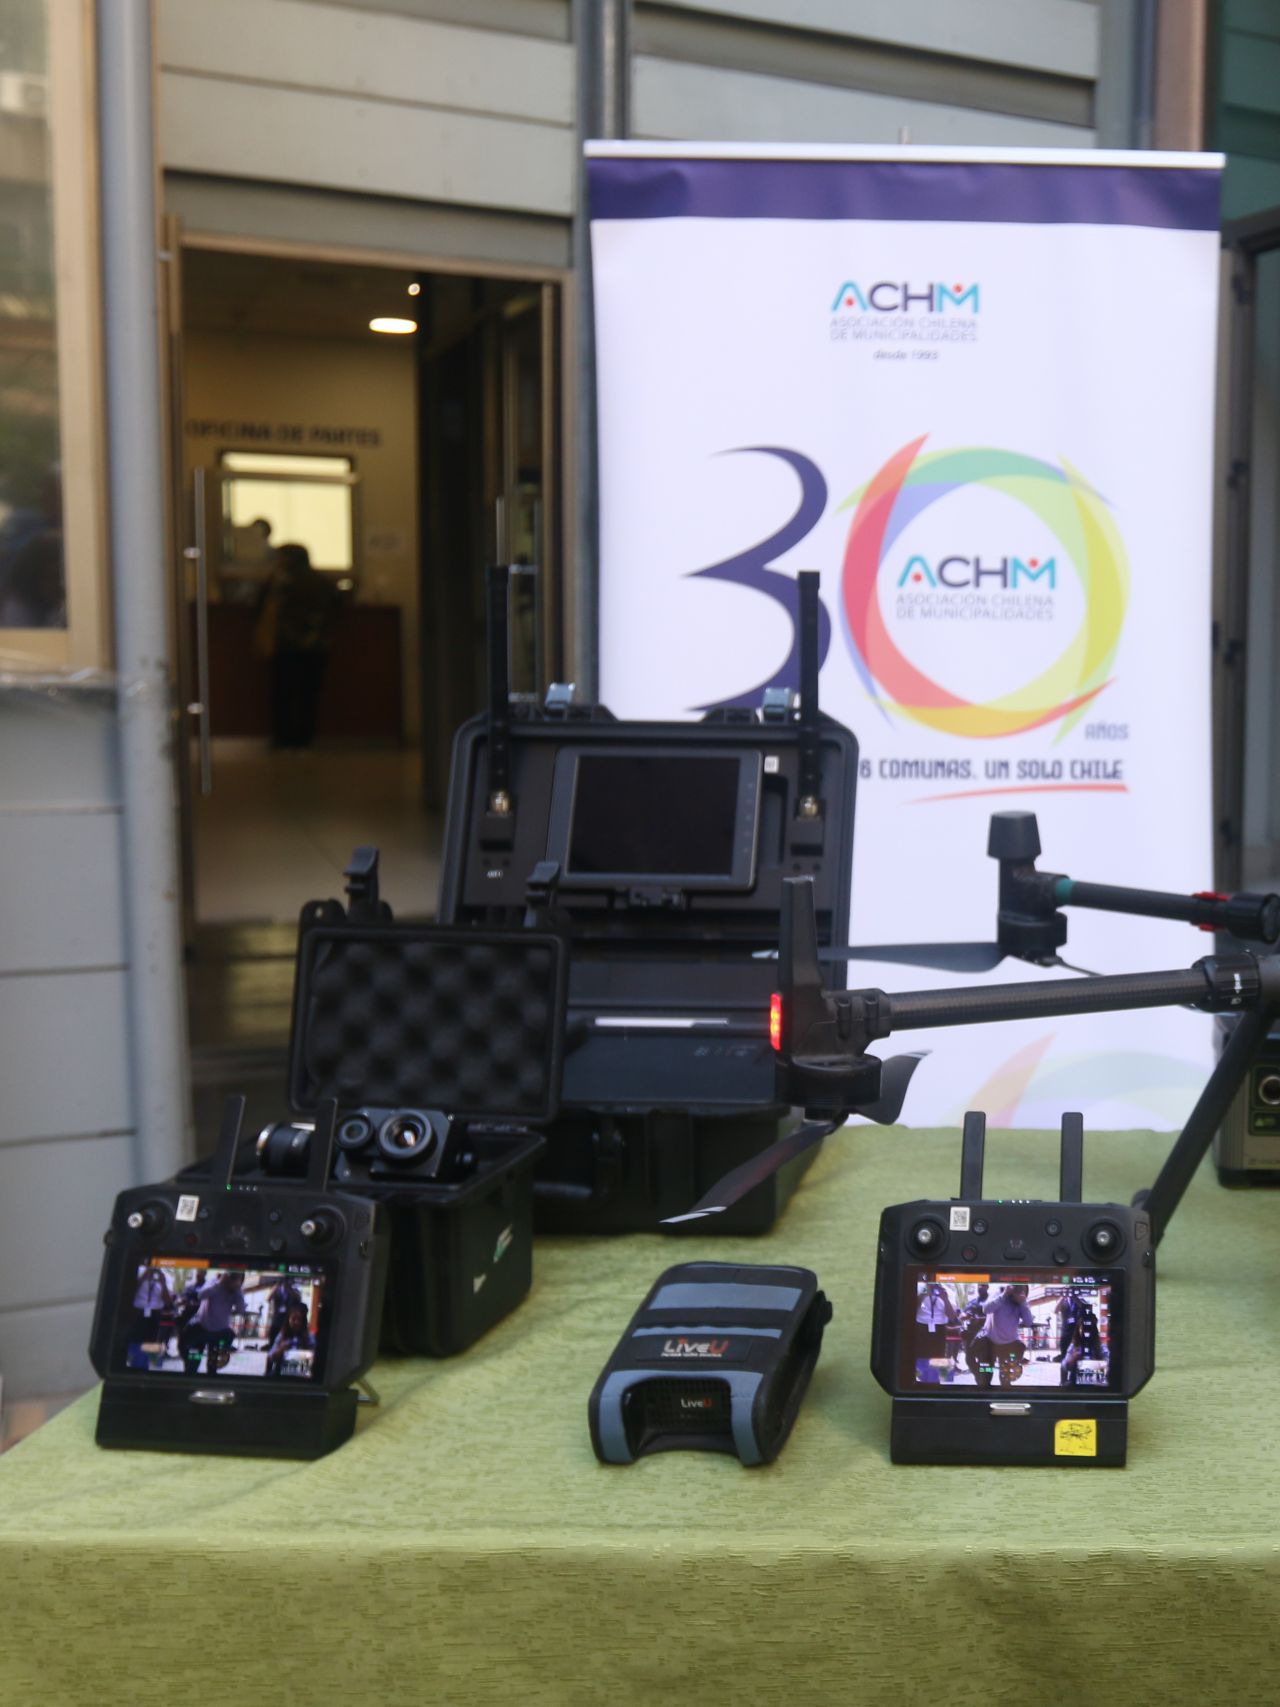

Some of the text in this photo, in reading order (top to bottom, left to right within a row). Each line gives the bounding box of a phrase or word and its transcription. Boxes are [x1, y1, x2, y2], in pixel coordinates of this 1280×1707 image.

[832, 280, 979, 313] ACHM
[919, 318, 977, 329] CHILENA
[830, 328, 977, 341] DE MUNICIPALIDADES
[873, 350, 907, 360] desde
[897, 555, 1056, 589] ACHM
[991, 594, 1054, 607] CHILENA
[896, 606, 1054, 621] DE MUNICIPALIDADES
[1084, 723, 1129, 740] AÑOS
[984, 760, 1010, 780] UN
[1017, 759, 1063, 780] SOLO
[1070, 759, 1123, 780] CHILE
